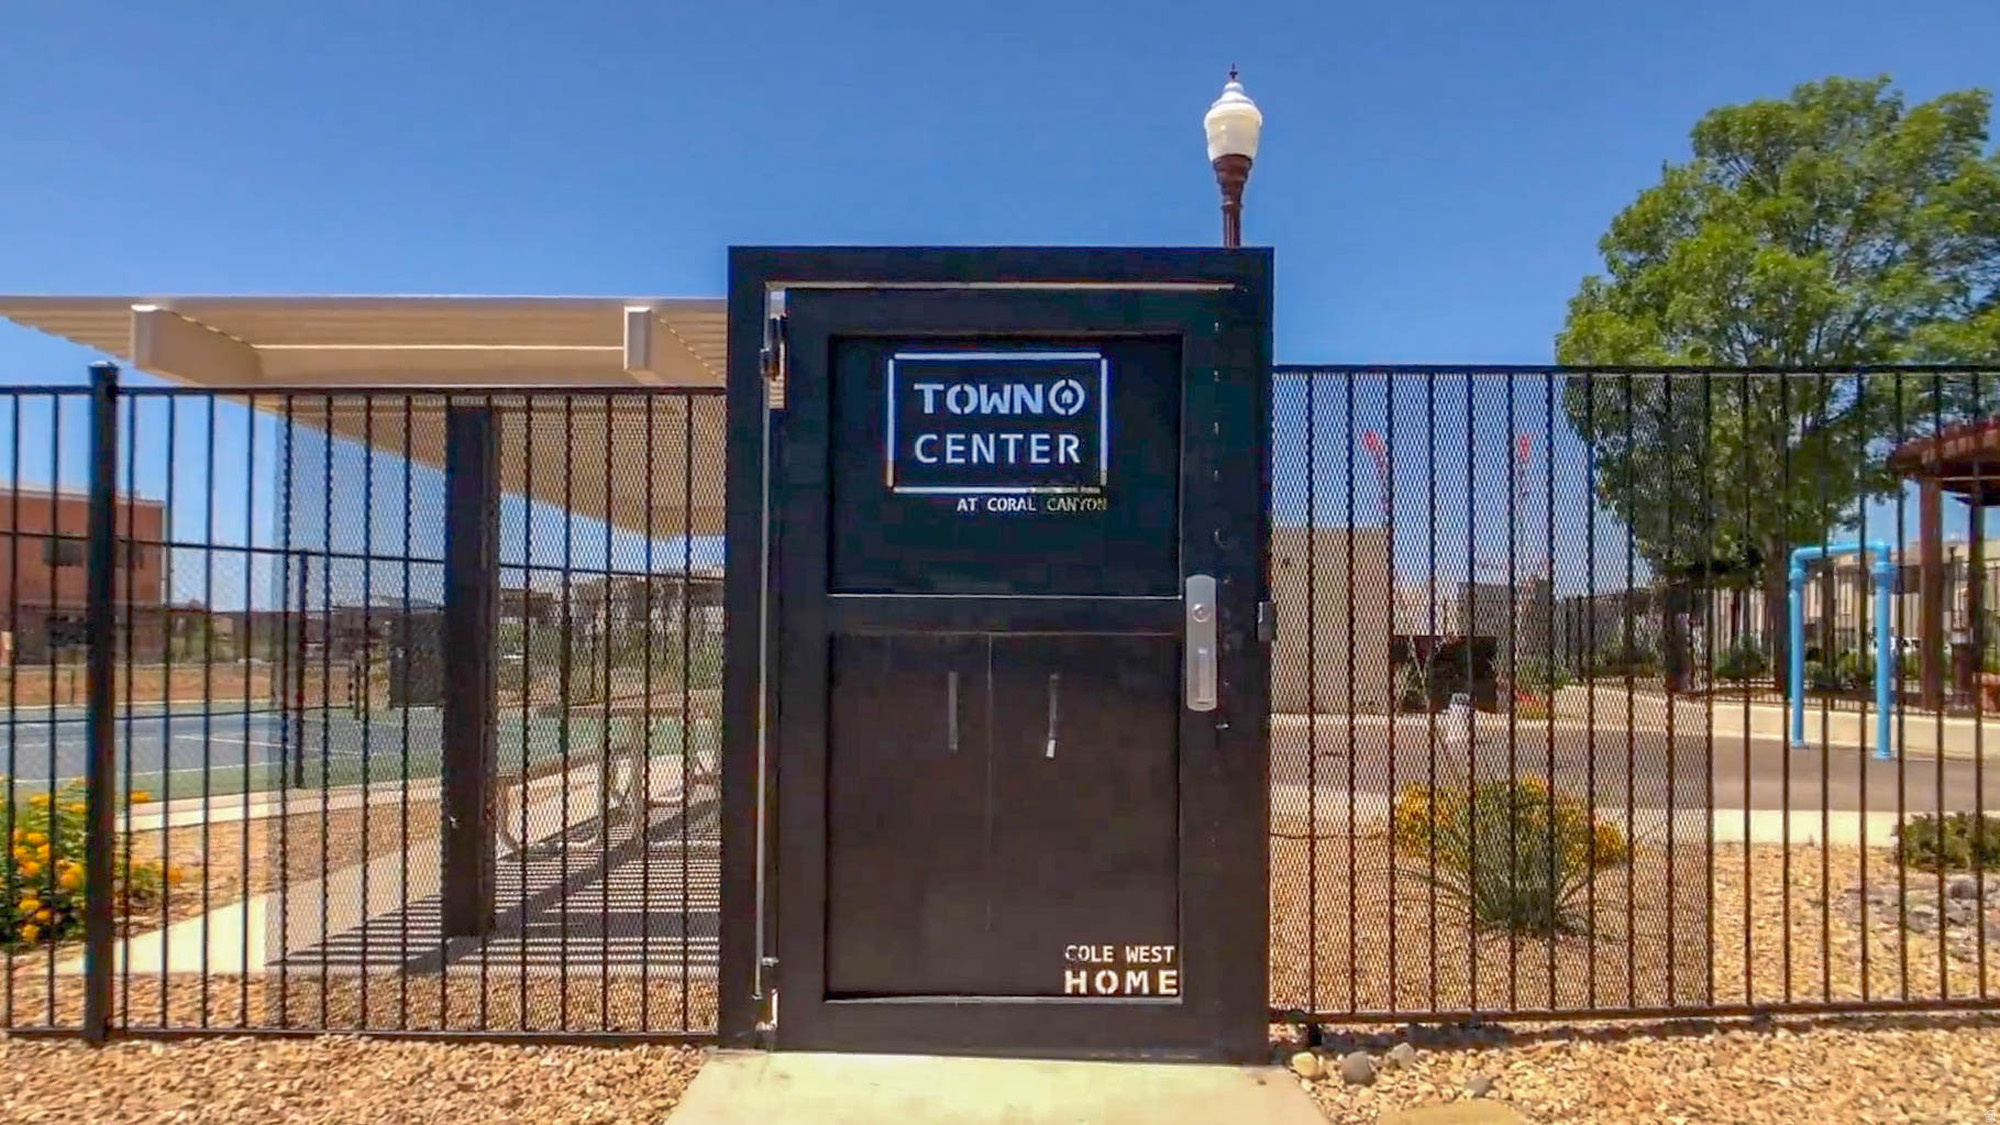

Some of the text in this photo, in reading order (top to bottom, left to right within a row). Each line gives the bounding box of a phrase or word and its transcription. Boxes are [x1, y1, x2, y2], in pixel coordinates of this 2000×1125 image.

[913, 383, 1043, 415] TOWN
[914, 433, 1081, 464] CENTER
[957, 497, 1107, 512] AT CORAL CANYON
[1065, 945, 1175, 963] COLE WEST
[1064, 969, 1178, 995] HOME
